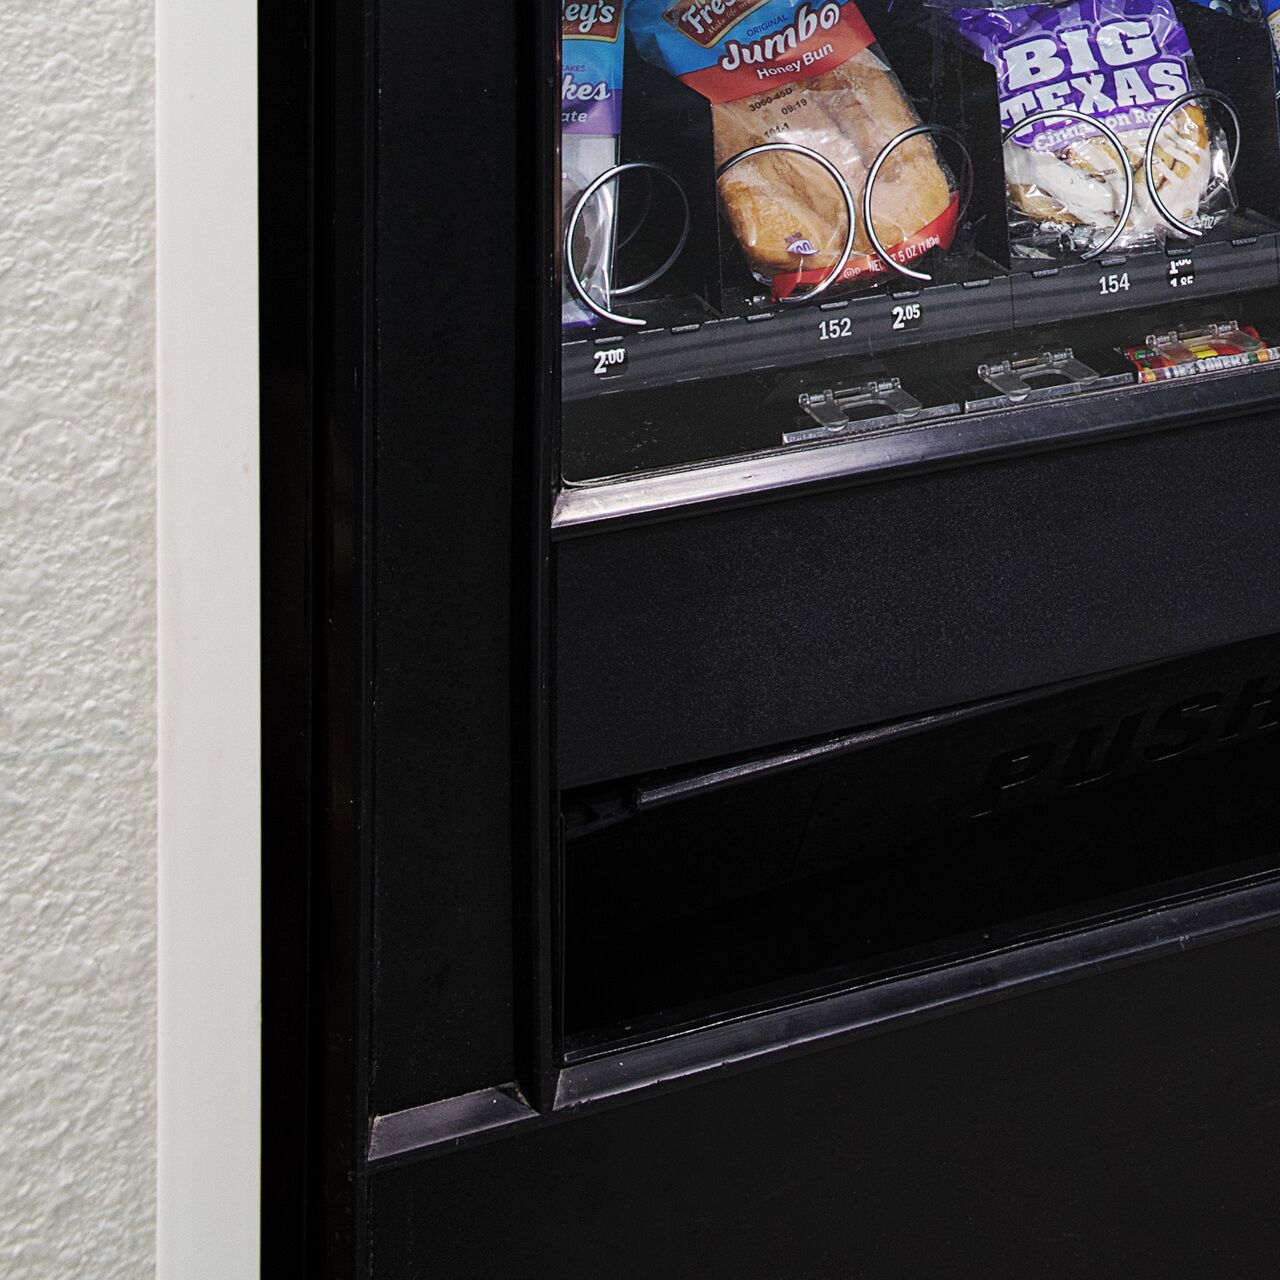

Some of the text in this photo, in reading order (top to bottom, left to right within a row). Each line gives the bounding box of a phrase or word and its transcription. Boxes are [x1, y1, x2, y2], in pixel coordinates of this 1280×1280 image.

[722, 3, 840, 71] Jumbo
[745, 14, 787, 38] ORIGINAL
[757, 44, 834, 80] Honey Bun
[1003, 21, 1158, 90] BIG
[1001, 61, 1187, 136] TEXAS
[1099, 274, 1131, 294] 154
[819, 318, 852, 340] 152
